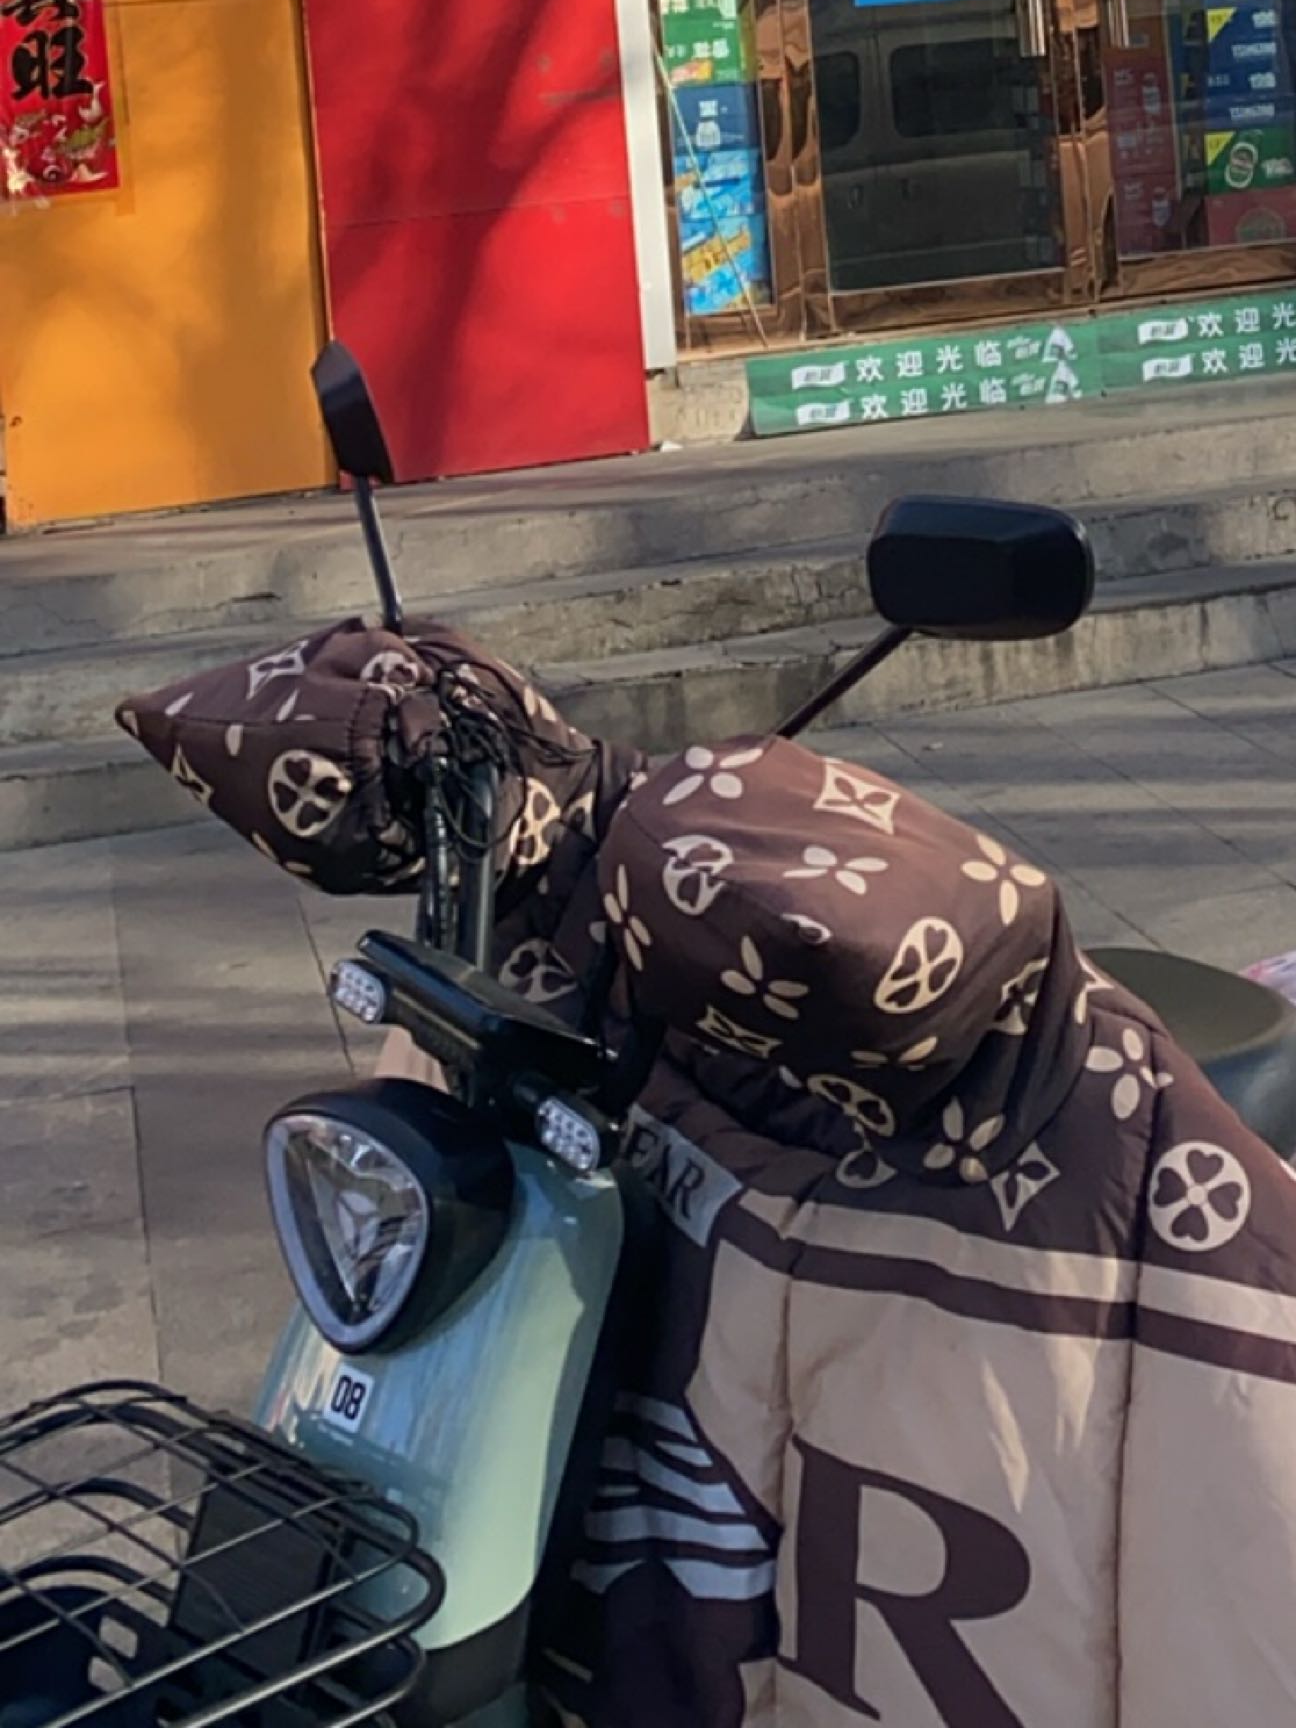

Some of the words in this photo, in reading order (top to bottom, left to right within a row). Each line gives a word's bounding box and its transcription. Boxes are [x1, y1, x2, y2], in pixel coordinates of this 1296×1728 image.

[855, 338, 1002, 383] 欢迎光临
[860, 375, 1007, 421] 欢迎光临
[331, 1374, 367, 1420] 08
[776, 1432, 1031, 1728] R
